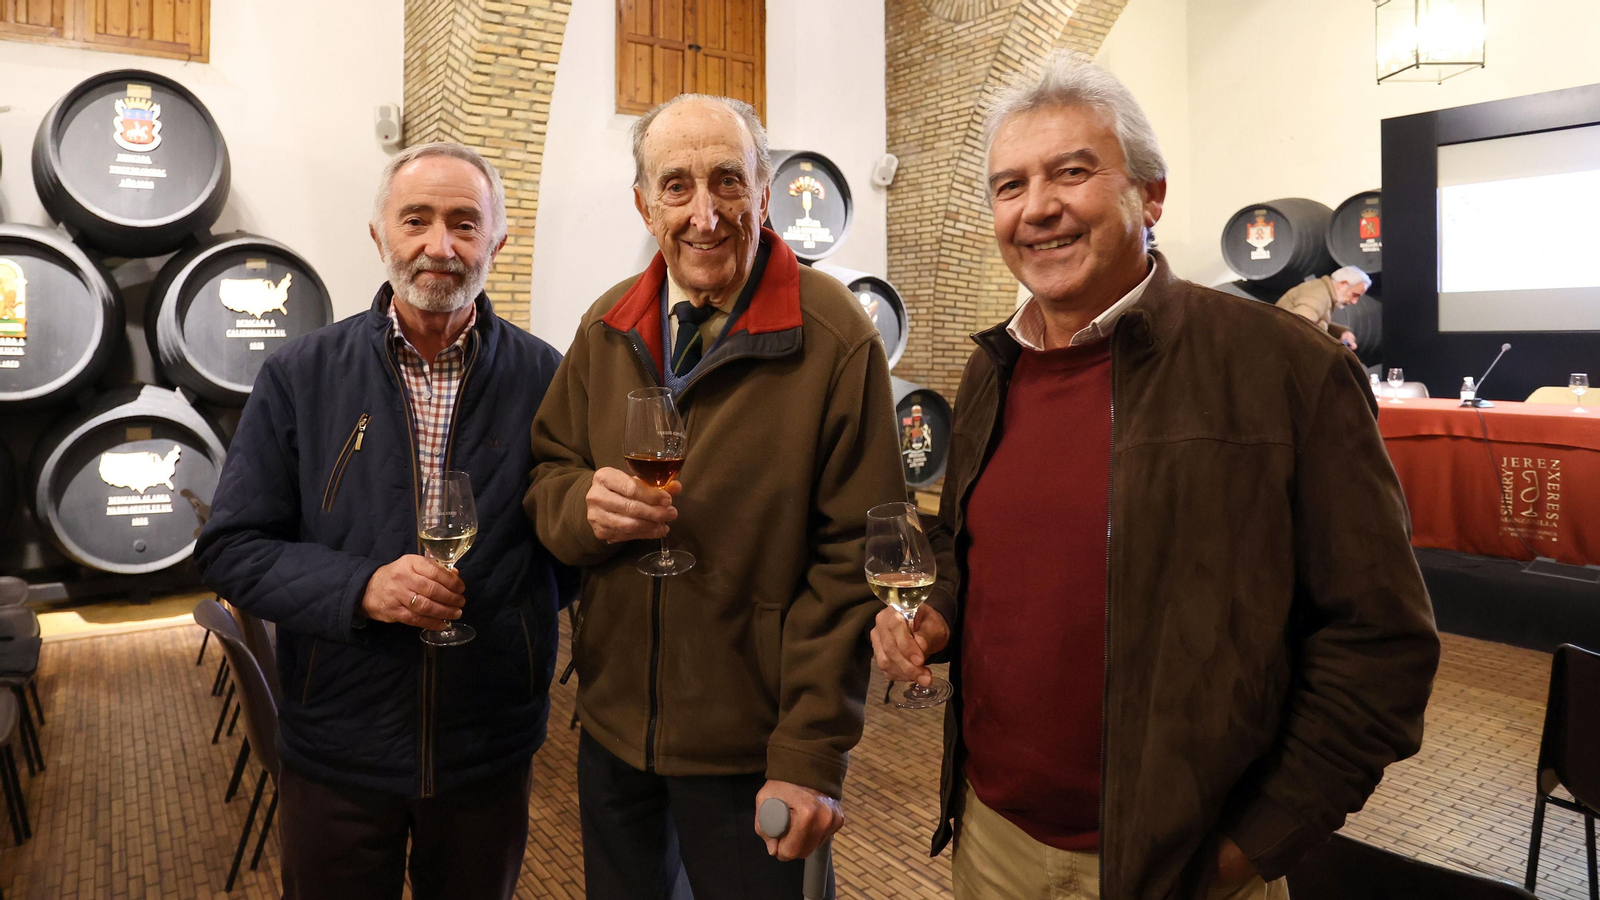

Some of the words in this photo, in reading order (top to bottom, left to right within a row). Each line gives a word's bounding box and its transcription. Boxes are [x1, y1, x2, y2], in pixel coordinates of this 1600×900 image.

[226, 329, 266, 338] CALIFORNIA
[1501, 456, 1561, 470] JEREZ
[1500, 468, 1514, 516] SHERRY
[1545, 470, 1561, 520] XERES
